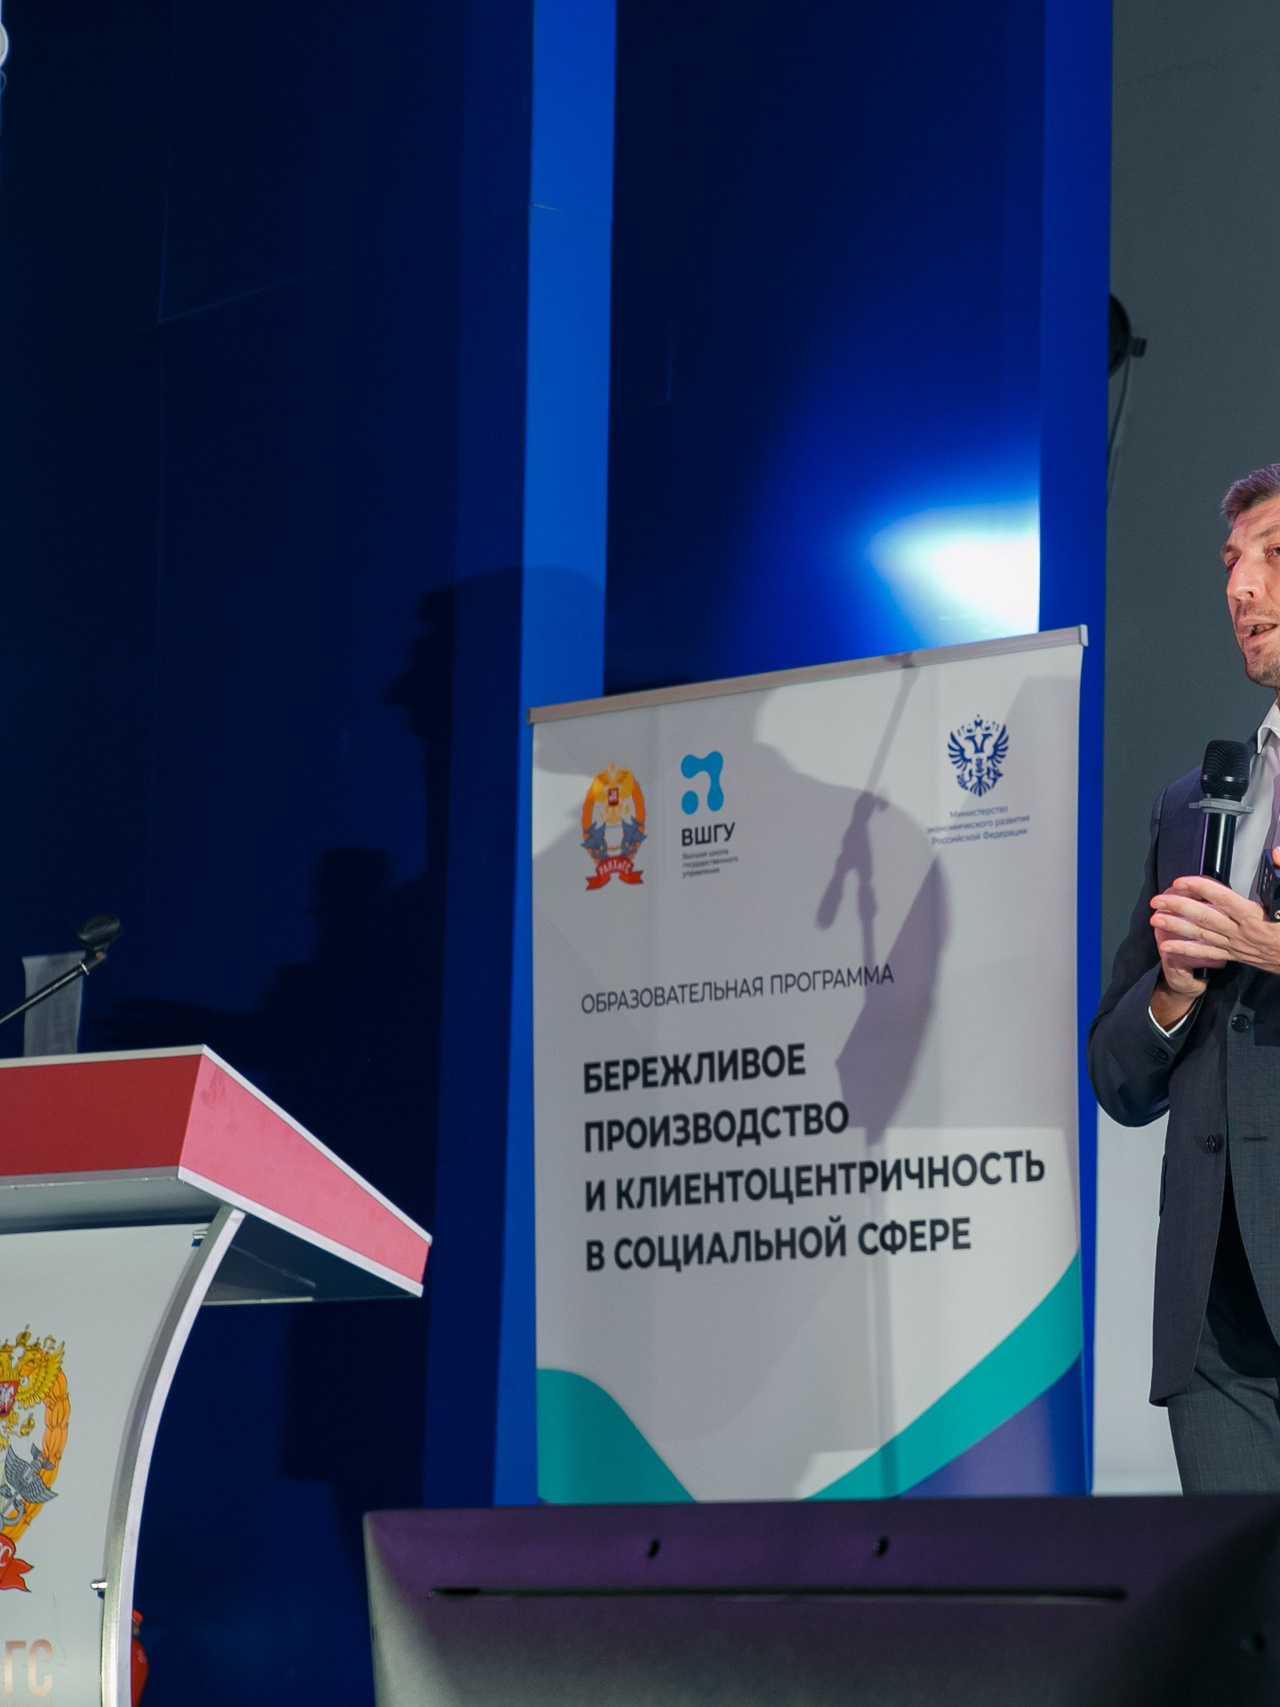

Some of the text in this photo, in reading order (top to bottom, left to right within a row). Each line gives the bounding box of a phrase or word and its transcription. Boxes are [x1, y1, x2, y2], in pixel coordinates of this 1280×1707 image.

[681, 821, 736, 847] ВШГУ
[581, 963, 895, 1014] ОБРАЗОВАТЕЛЬНАЯ ПРОГРАММА
[583, 1042, 807, 1094] БЕРЕЖЛИВОЕ
[584, 1101, 850, 1154] ПРОИЗВОДСТВО
[585, 1149, 1046, 1213] И КЛИЕНТОЦЕНТРИЧНОСТЬ
[585, 1215, 972, 1273] В СОЦИАЛЬНОЙ СФЕРЕ
